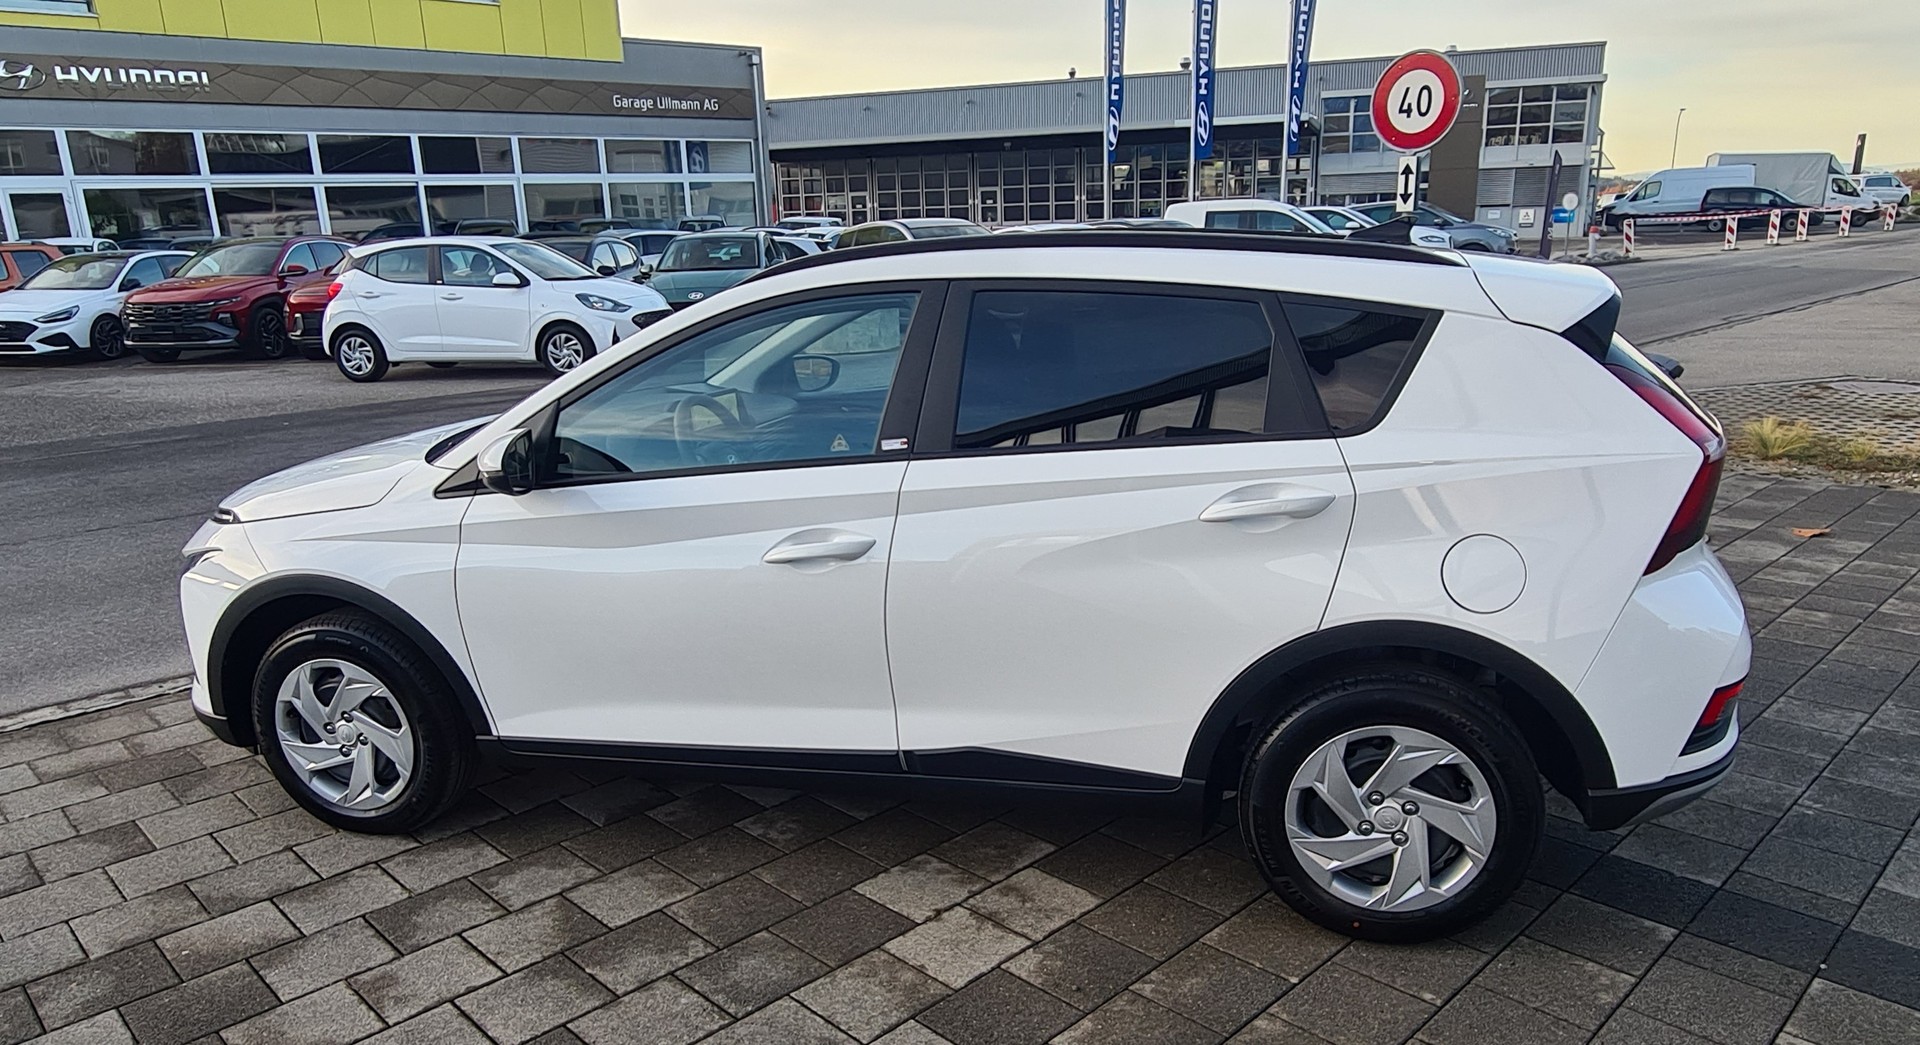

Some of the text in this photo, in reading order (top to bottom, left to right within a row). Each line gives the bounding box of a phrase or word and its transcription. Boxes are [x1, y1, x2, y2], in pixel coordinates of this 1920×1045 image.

[53, 64, 210, 92] HYUNDAI
[613, 95, 718, 111] Garage Ullmann AG
[1398, 84, 1432, 118] 40
